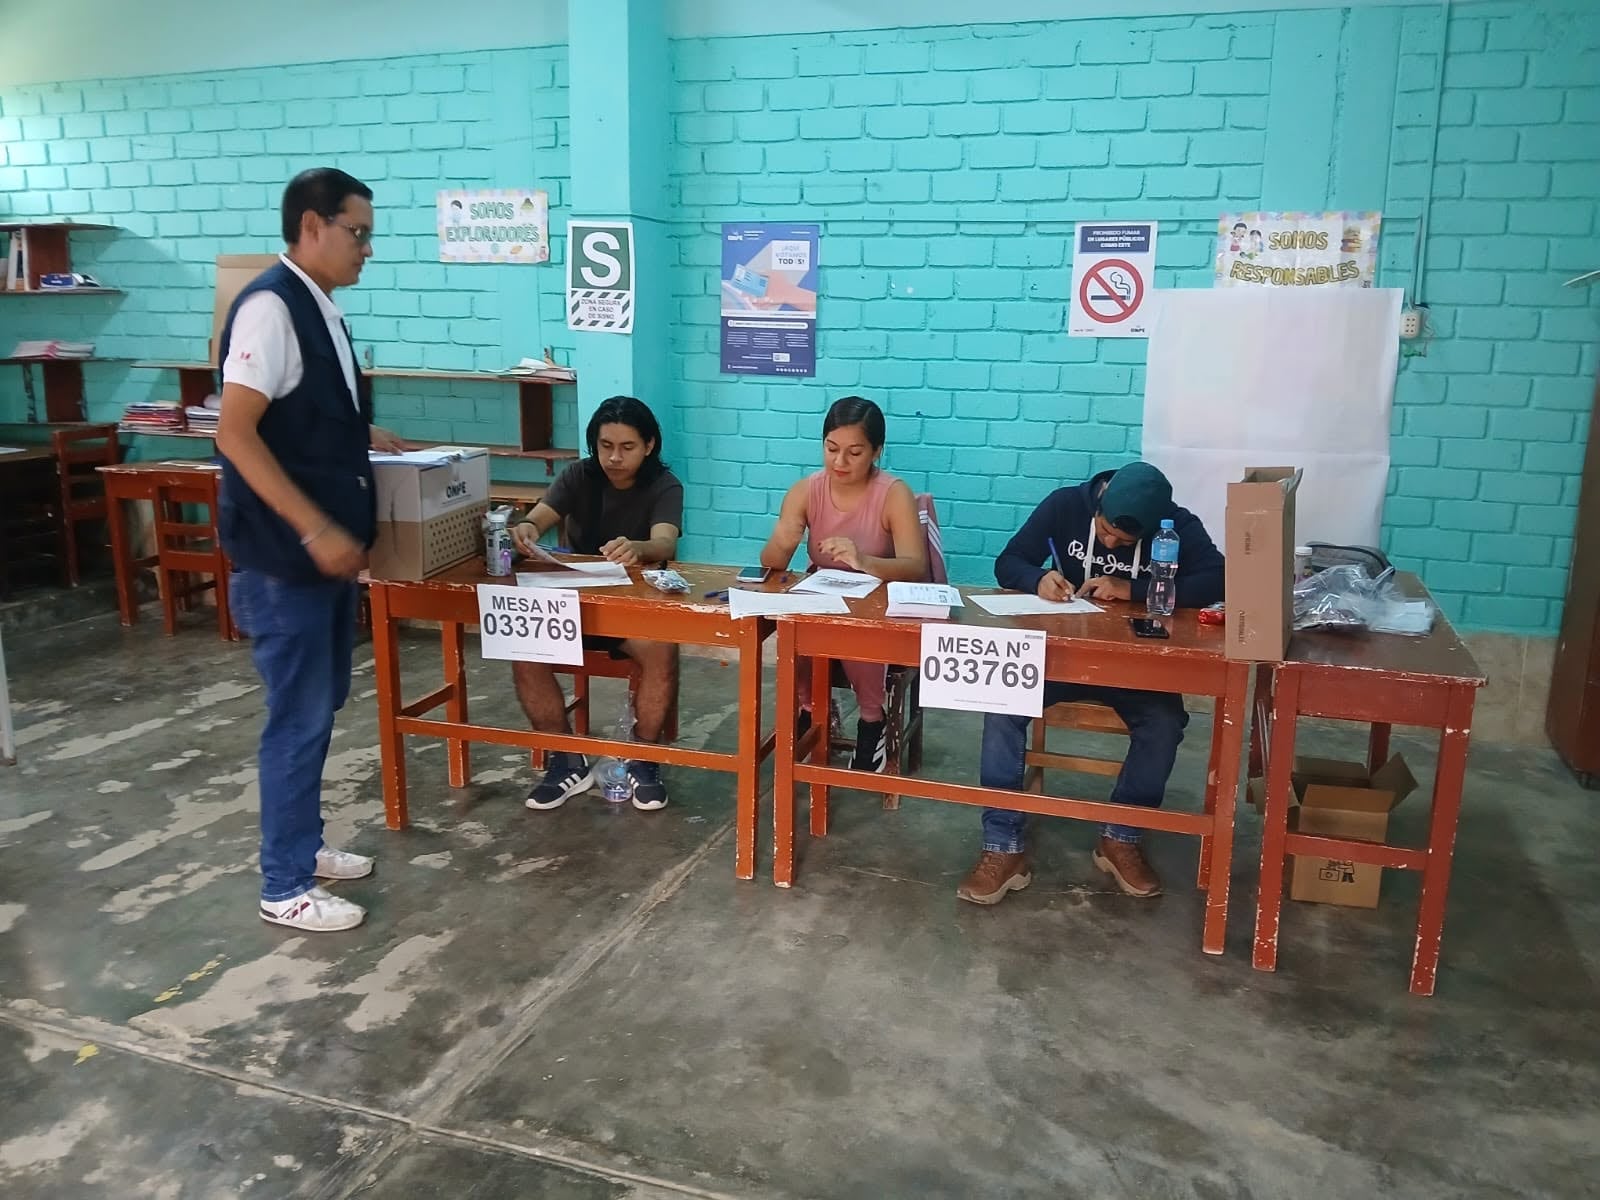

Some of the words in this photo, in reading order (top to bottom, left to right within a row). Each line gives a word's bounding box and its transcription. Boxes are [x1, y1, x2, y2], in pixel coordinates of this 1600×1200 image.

[469, 201, 514, 219] SOMOS
[445, 224, 540, 242] EXPLORADORES
[1269, 231, 1328, 250] SOMOS
[580, 232, 622, 287] S
[1230, 260, 1360, 286] RESPONSABLES
[492, 595, 543, 613] MESA
[483, 612, 577, 641] 033769
[938, 636, 1000, 657] MESA
[924, 655, 1039, 689] 033769
